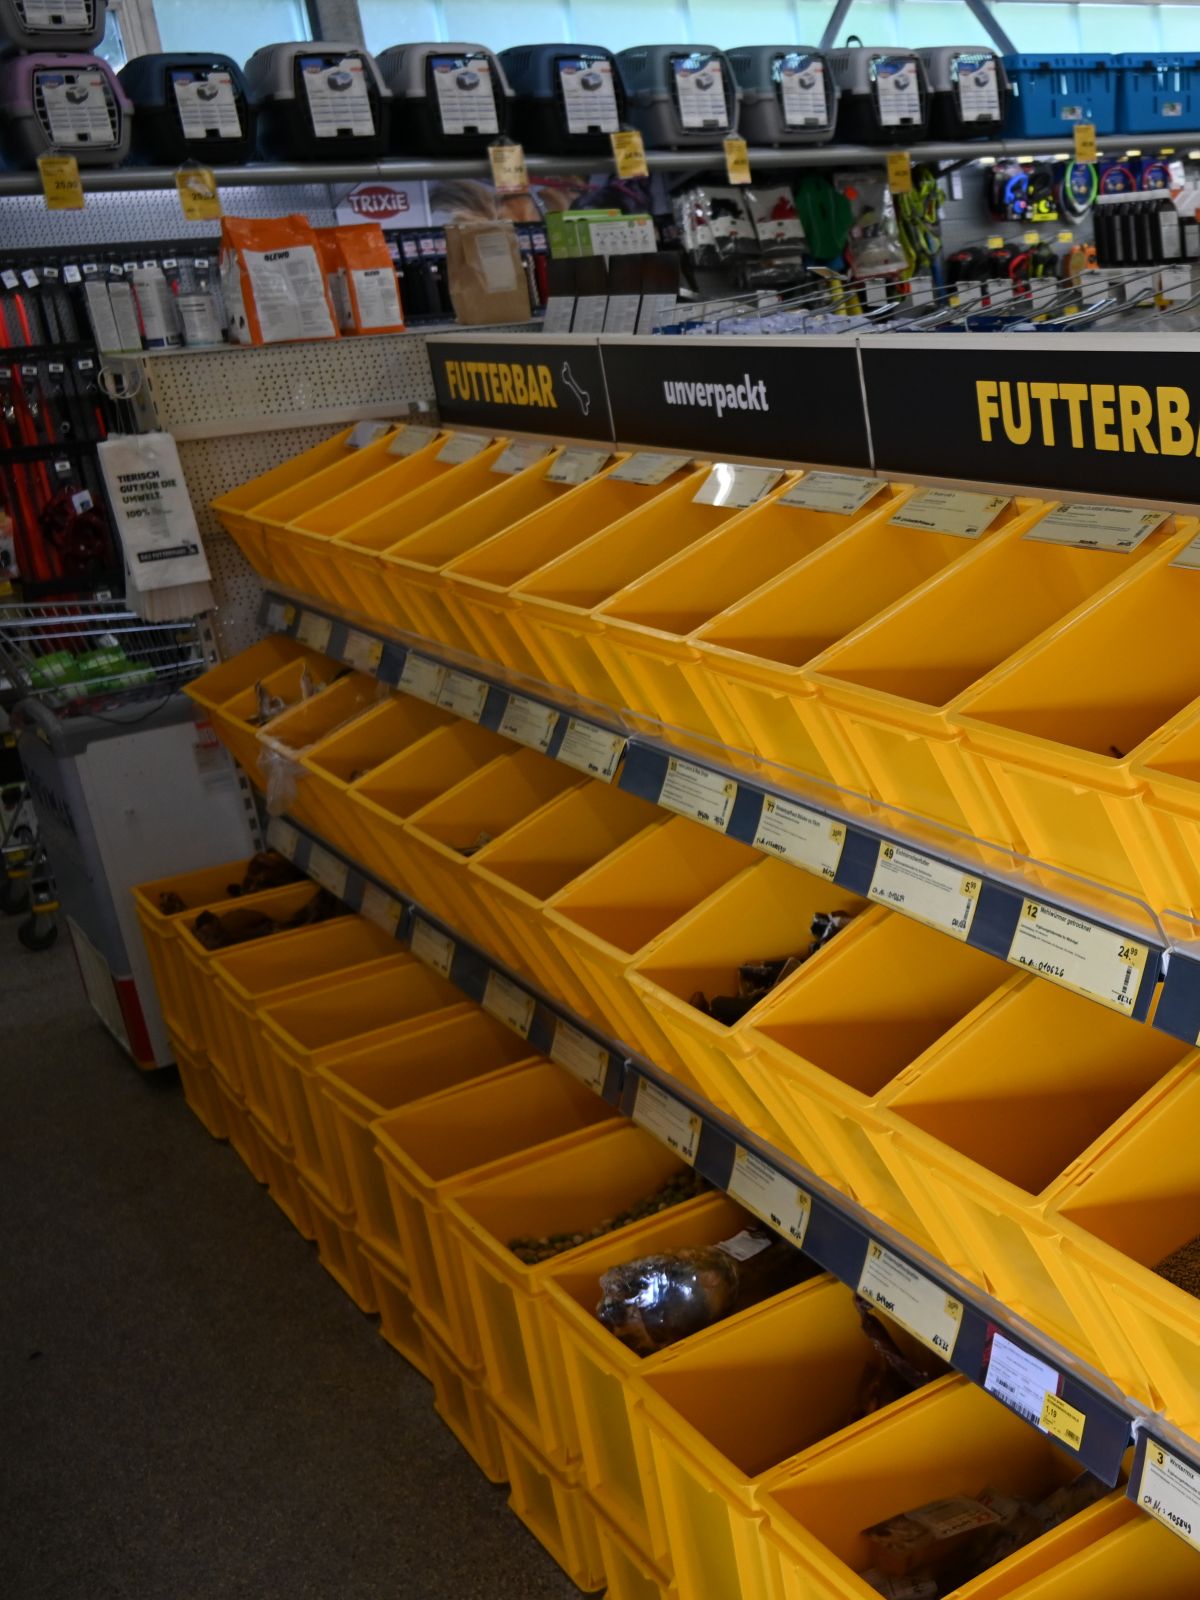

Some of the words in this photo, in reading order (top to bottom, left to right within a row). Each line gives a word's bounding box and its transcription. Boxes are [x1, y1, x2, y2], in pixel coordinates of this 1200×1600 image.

[444, 360, 557, 410] FUTTERBAR
[663, 374, 769, 415] unverpackt
[117, 470, 160, 484] TIERISCH
[119, 483, 138, 494] GUT
[138, 479, 160, 493] FÜR
[160, 478, 177, 489] DIE
[1026, 904, 1038, 919] 12
[1066, 917, 1091, 934] getrocknet
[1117, 945, 1138, 961] 24.99
[1156, 1451, 1165, 1465] 3
[1168, 1456, 1194, 1480] Wintermix
